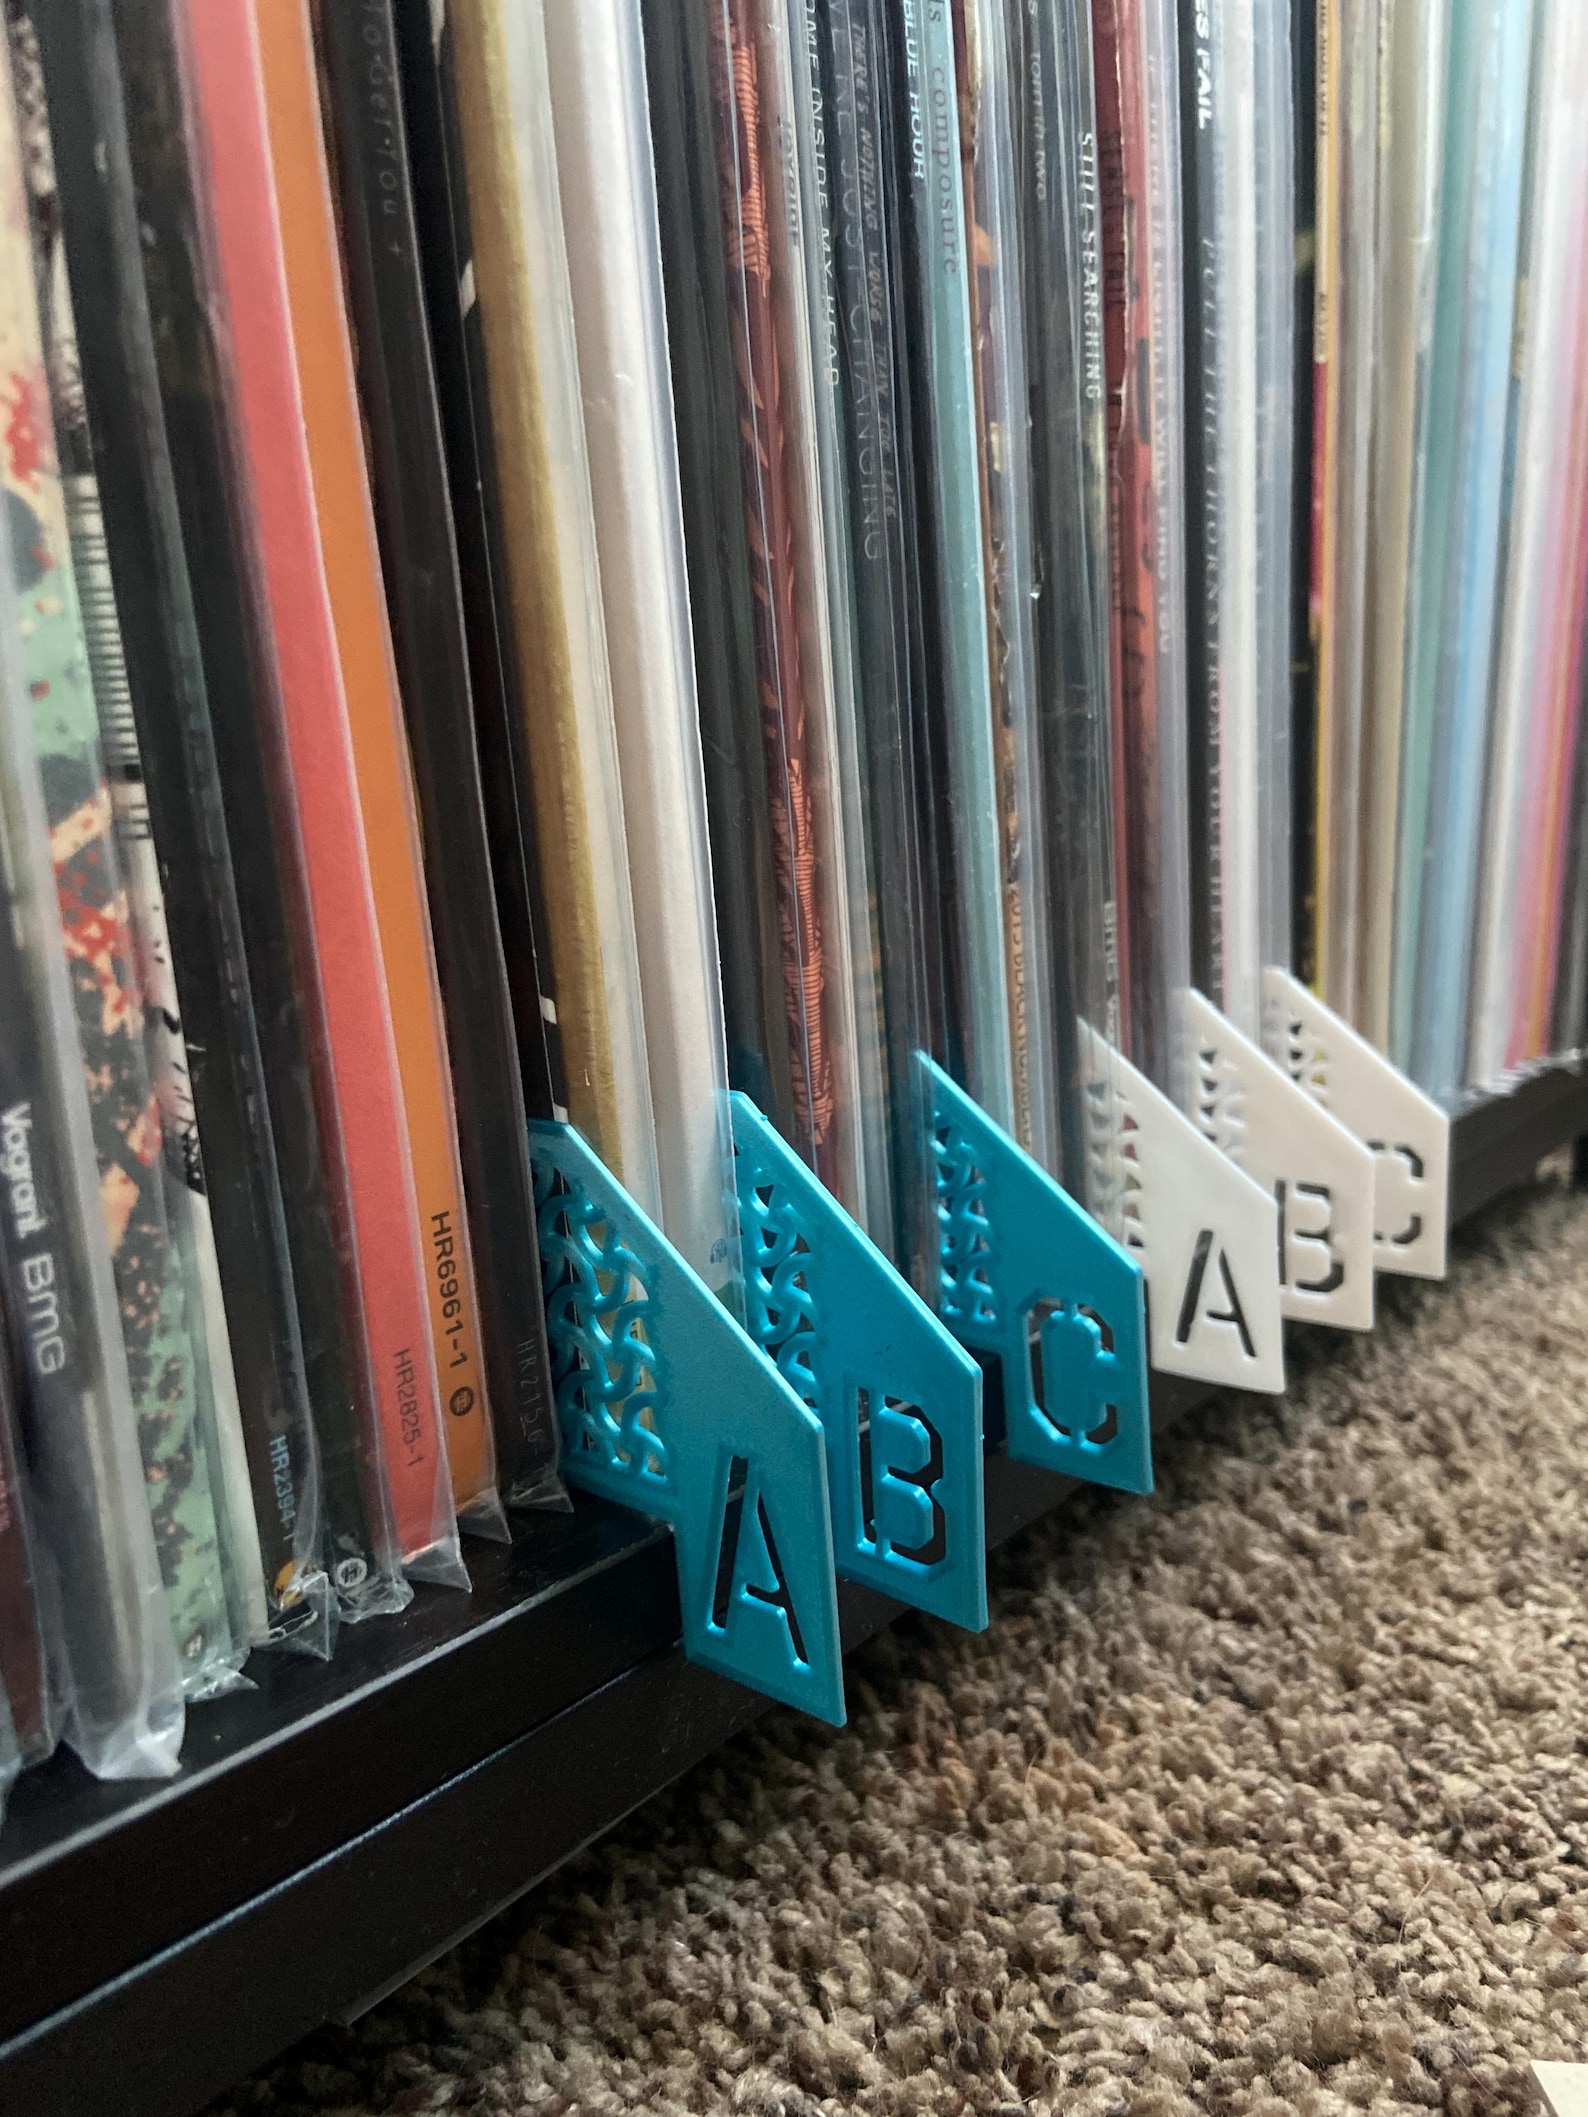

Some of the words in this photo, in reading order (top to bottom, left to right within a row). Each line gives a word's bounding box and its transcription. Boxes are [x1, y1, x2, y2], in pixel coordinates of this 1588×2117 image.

[852, 23, 870, 115] THERE'S
[902, 0, 920, 77] BLUE
[928, 0, 945, 23] s
[909, 91, 927, 181] HOUR
[1196, 48, 1213, 130] FAIL
[859, 127, 879, 231] NOTHING
[931, 66, 957, 274] composure
[1077, 131, 1097, 216] STILL
[867, 251, 885, 326] WORSE
[1081, 229, 1103, 400] SEARCHING
[0, 1101, 48, 1239] Vagrant
[1366, 1139, 1425, 1246] C
[430, 1210, 469, 1368] HR6961-1
[1175, 1228, 1258, 1359] A
[1274, 1178, 1345, 1294] B
[19, 1252, 66, 1375] BMG
[1020, 1291, 1118, 1449] C
[393, 1347, 425, 1468] HR2825-1
[517, 1337, 545, 1460] HR2156-
[850, 1385, 948, 1568] B
[707, 1454, 812, 1668] A
